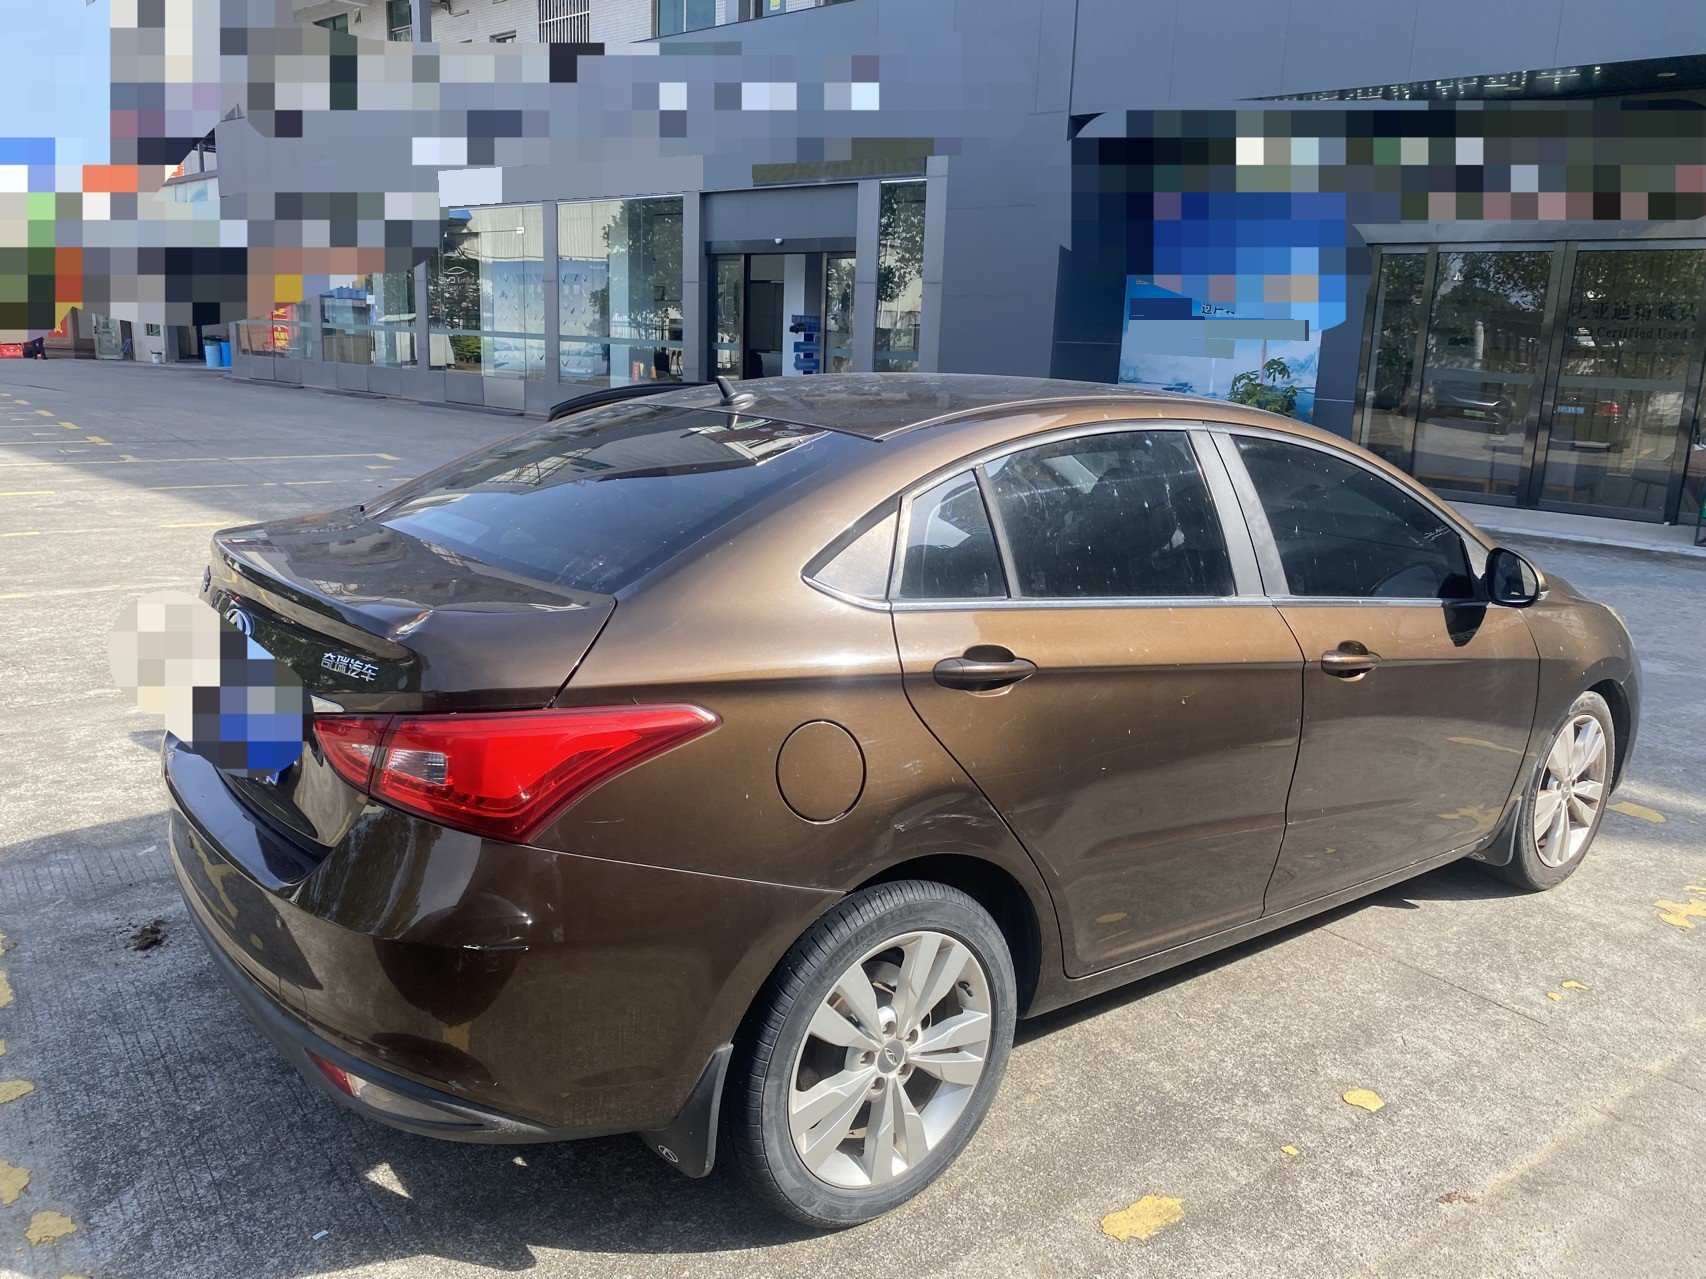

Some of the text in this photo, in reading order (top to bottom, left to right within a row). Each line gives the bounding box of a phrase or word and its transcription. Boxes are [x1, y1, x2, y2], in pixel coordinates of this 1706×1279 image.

[1597, 327, 1654, 339] Certified
[1658, 328, 1689, 339] Used
[320, 652, 380, 682] 奇瑞汽车
